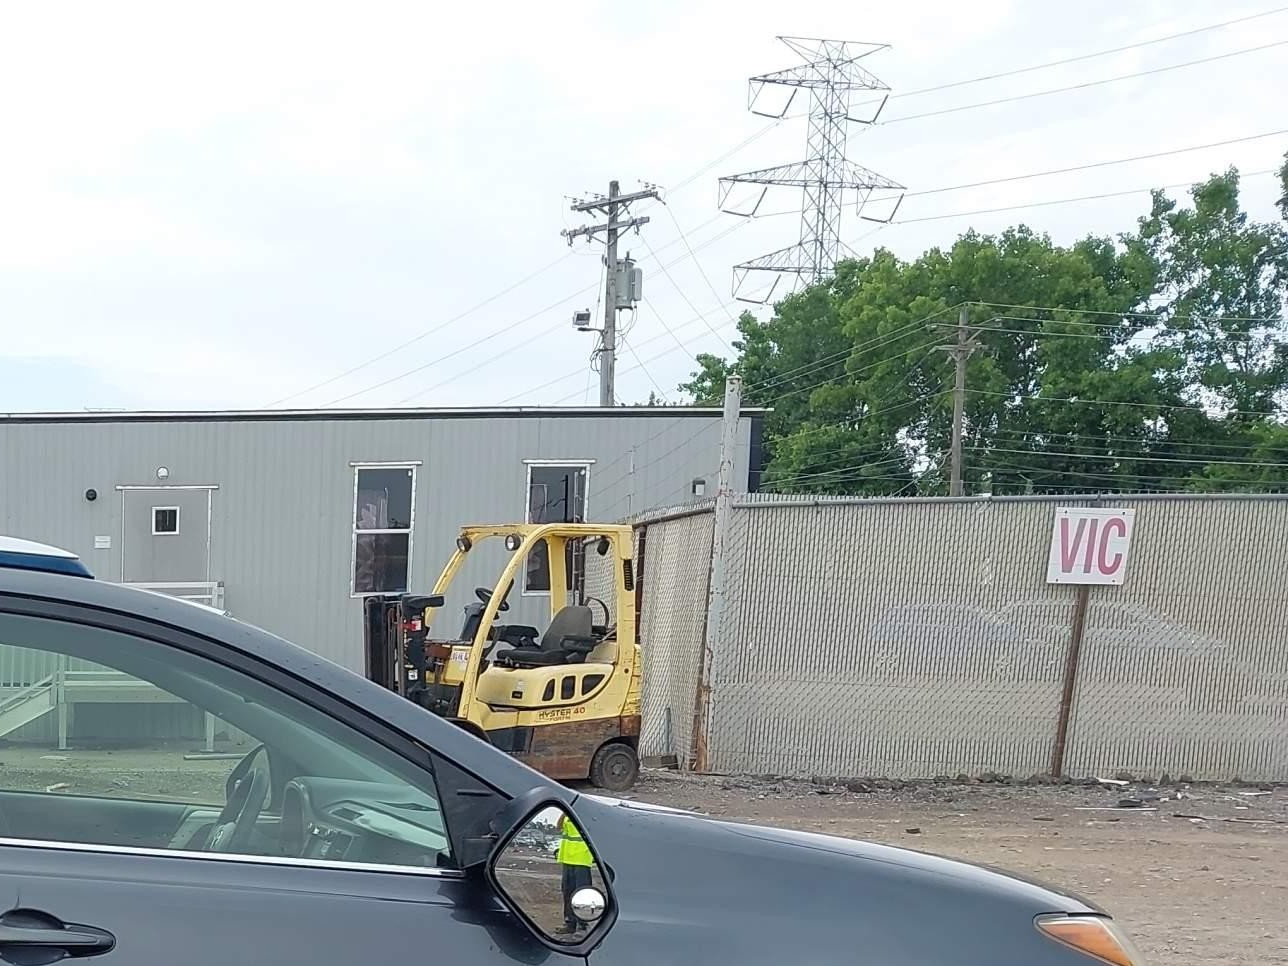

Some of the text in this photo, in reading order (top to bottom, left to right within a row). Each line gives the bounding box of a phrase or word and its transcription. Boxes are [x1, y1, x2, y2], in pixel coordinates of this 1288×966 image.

[1060, 517, 1127, 576] VIC
[538, 706, 586, 718] HYSTER 40
